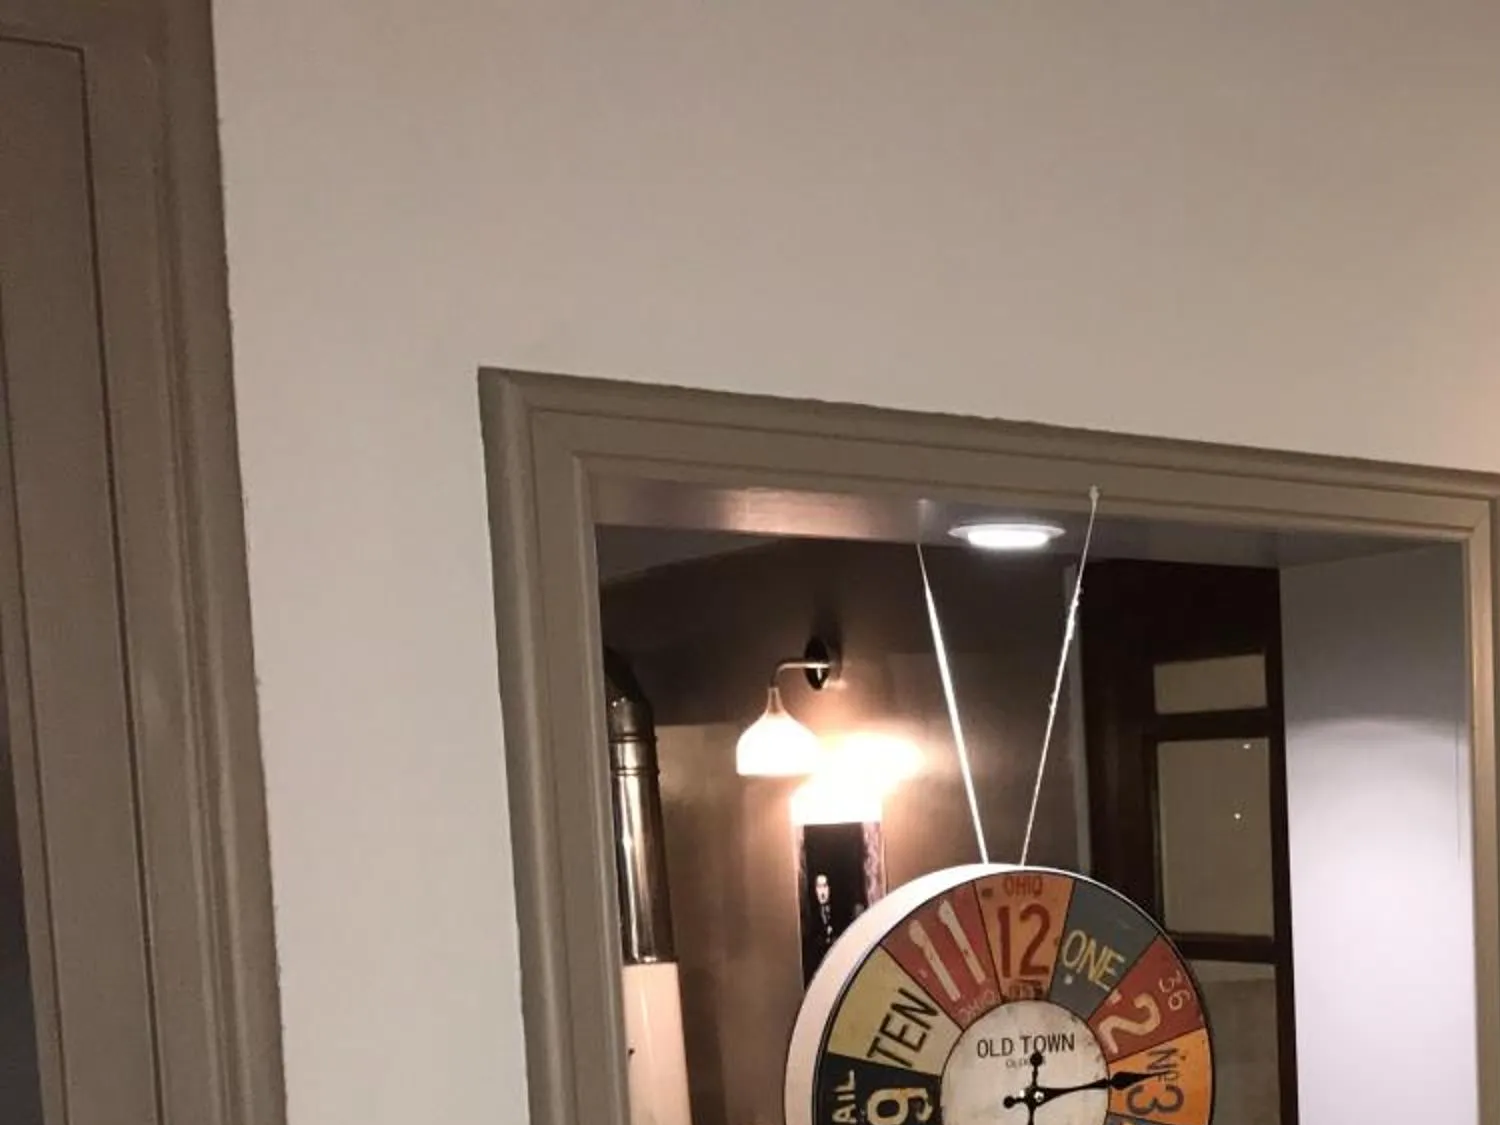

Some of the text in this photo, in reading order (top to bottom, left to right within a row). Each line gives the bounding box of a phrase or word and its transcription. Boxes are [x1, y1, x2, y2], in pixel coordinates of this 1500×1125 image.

[999, 904, 1050, 978] 12
[1062, 929, 1122, 991] ONE
[866, 988, 941, 1068] TEN
[977, 1031, 1075, 1058] OLD TOWN
[1099, 993, 1161, 1054] 2
[1128, 1083, 1184, 1115] 3
